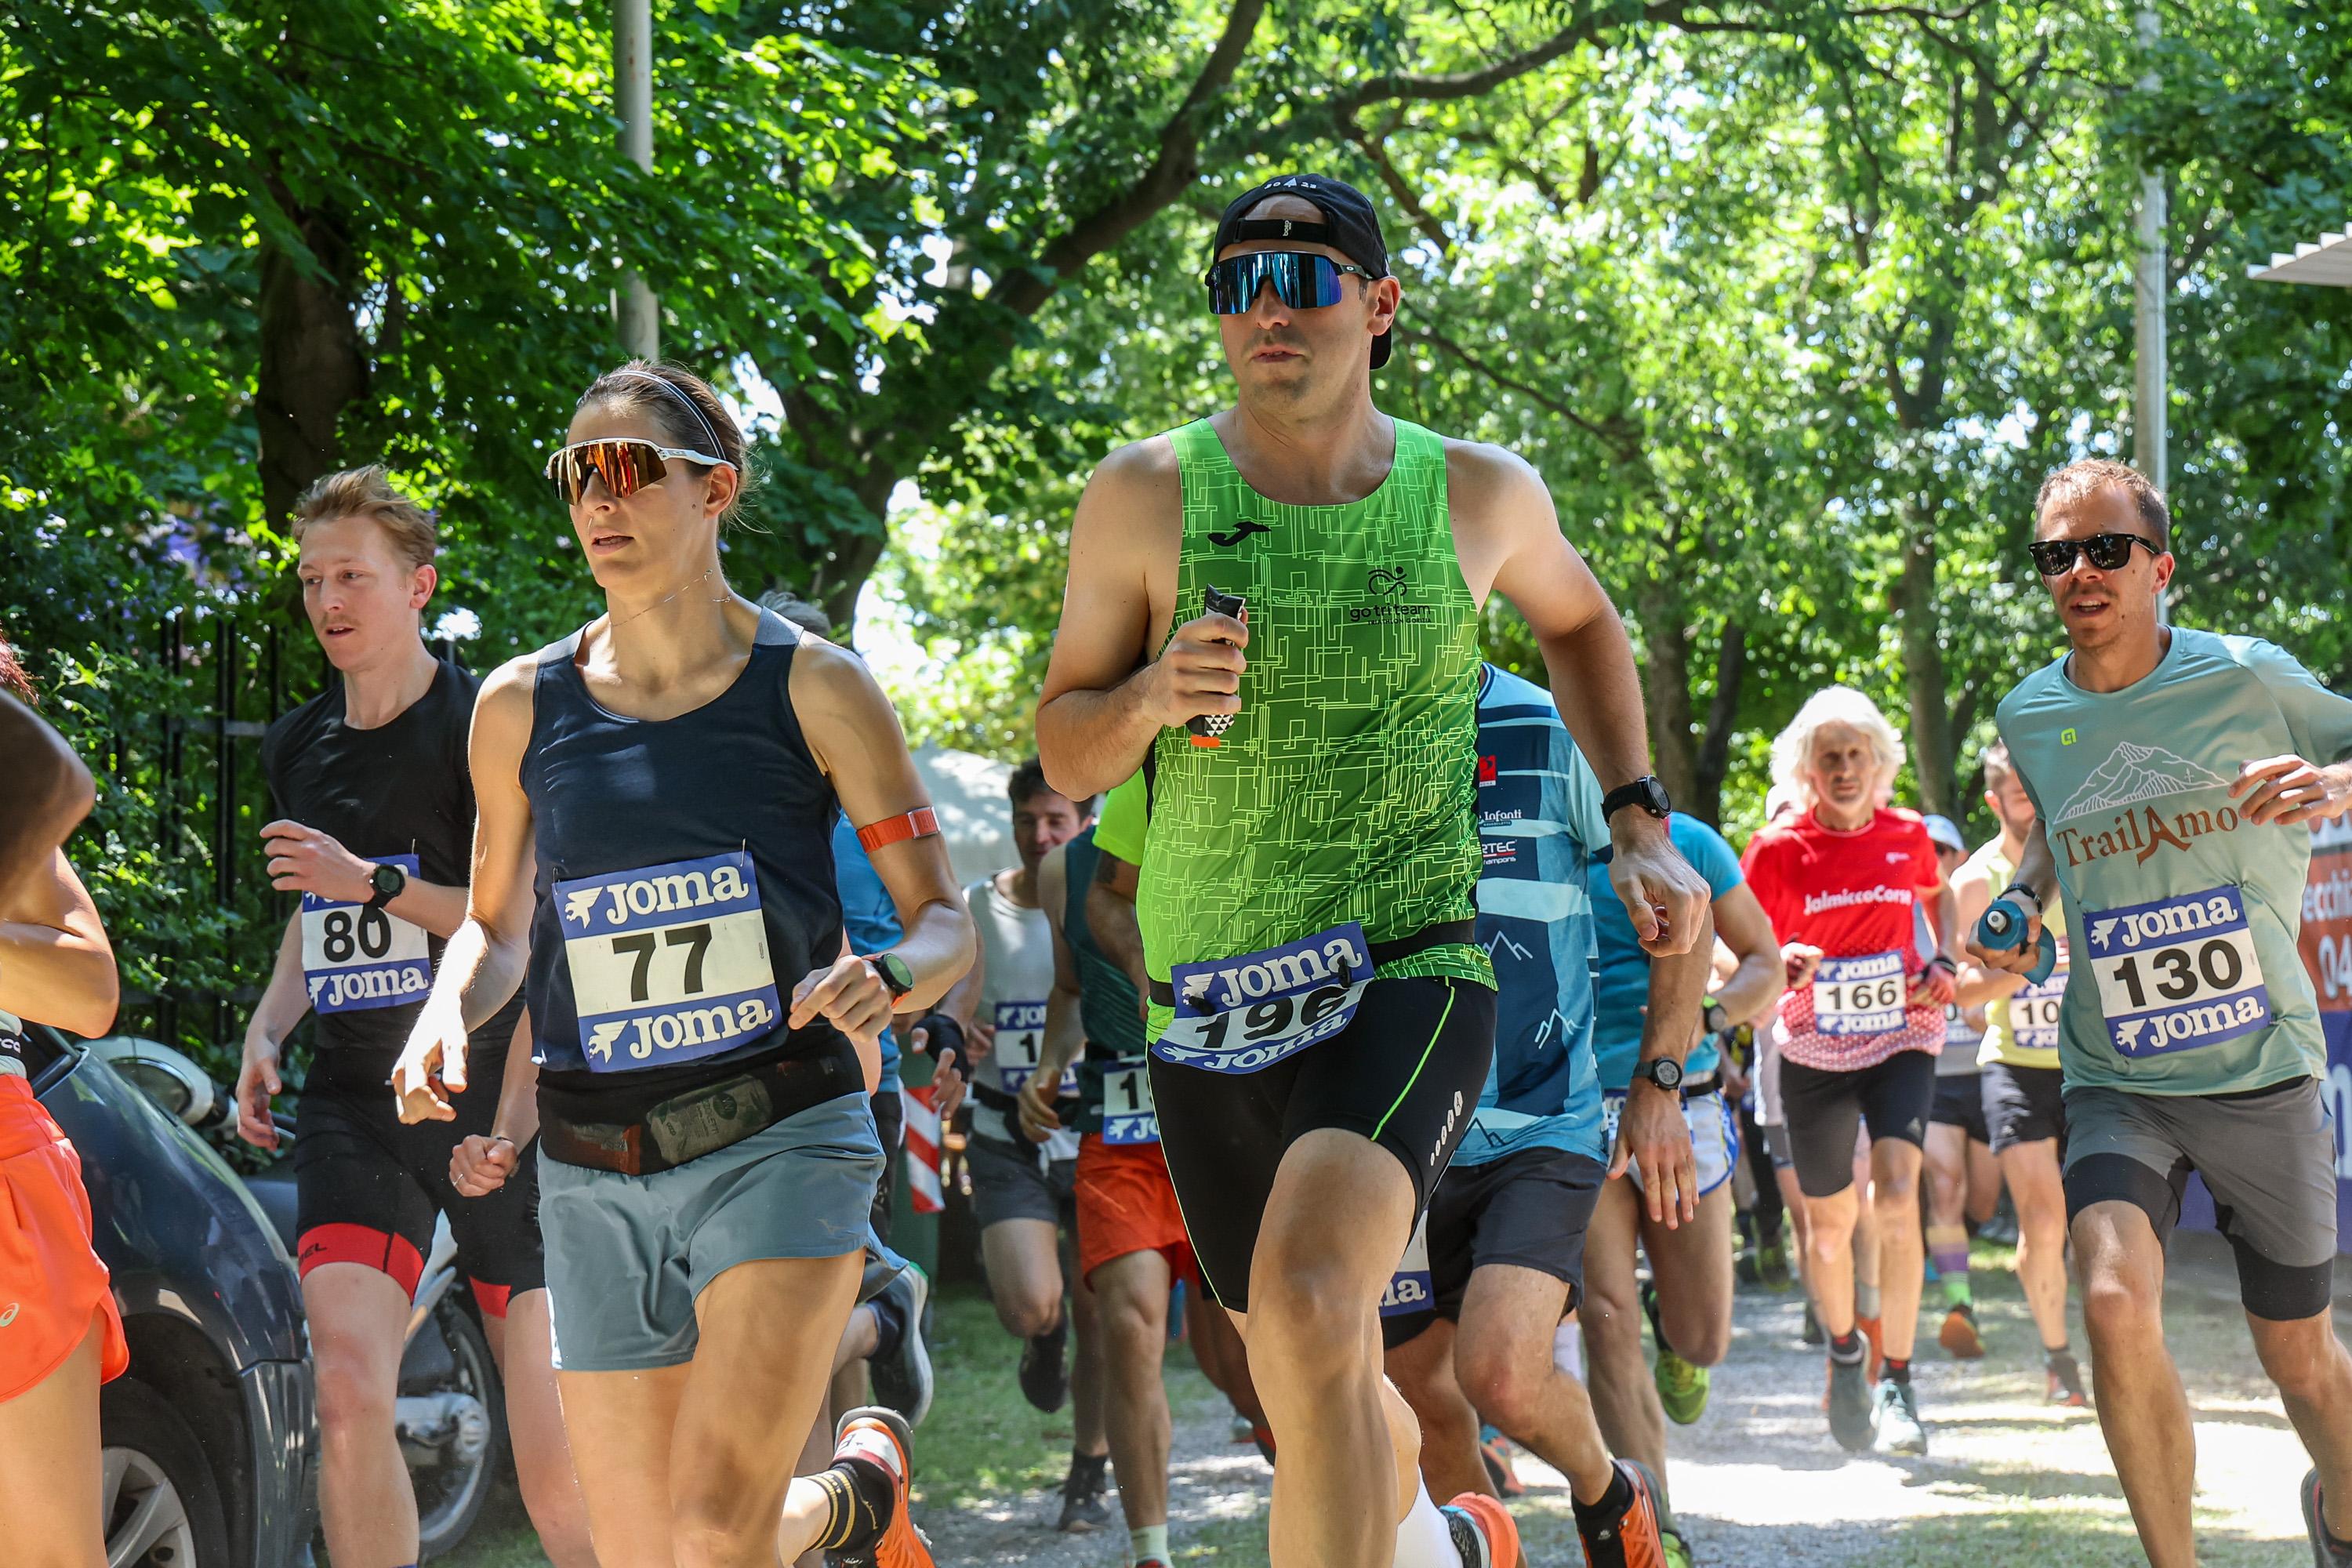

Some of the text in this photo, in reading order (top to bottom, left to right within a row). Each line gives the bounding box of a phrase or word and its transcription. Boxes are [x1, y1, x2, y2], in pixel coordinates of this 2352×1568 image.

[2056, 804, 2239, 869] TrailAmo
[323, 905, 392, 963] 80
[612, 924, 713, 1003] 77
[1828, 980, 1896, 1010] 166
[2113, 938, 2243, 1009] 130
[1195, 985, 1351, 1048] 196
[2021, 1001, 2060, 1024] 10
[1120, 1071, 1139, 1110] 1
